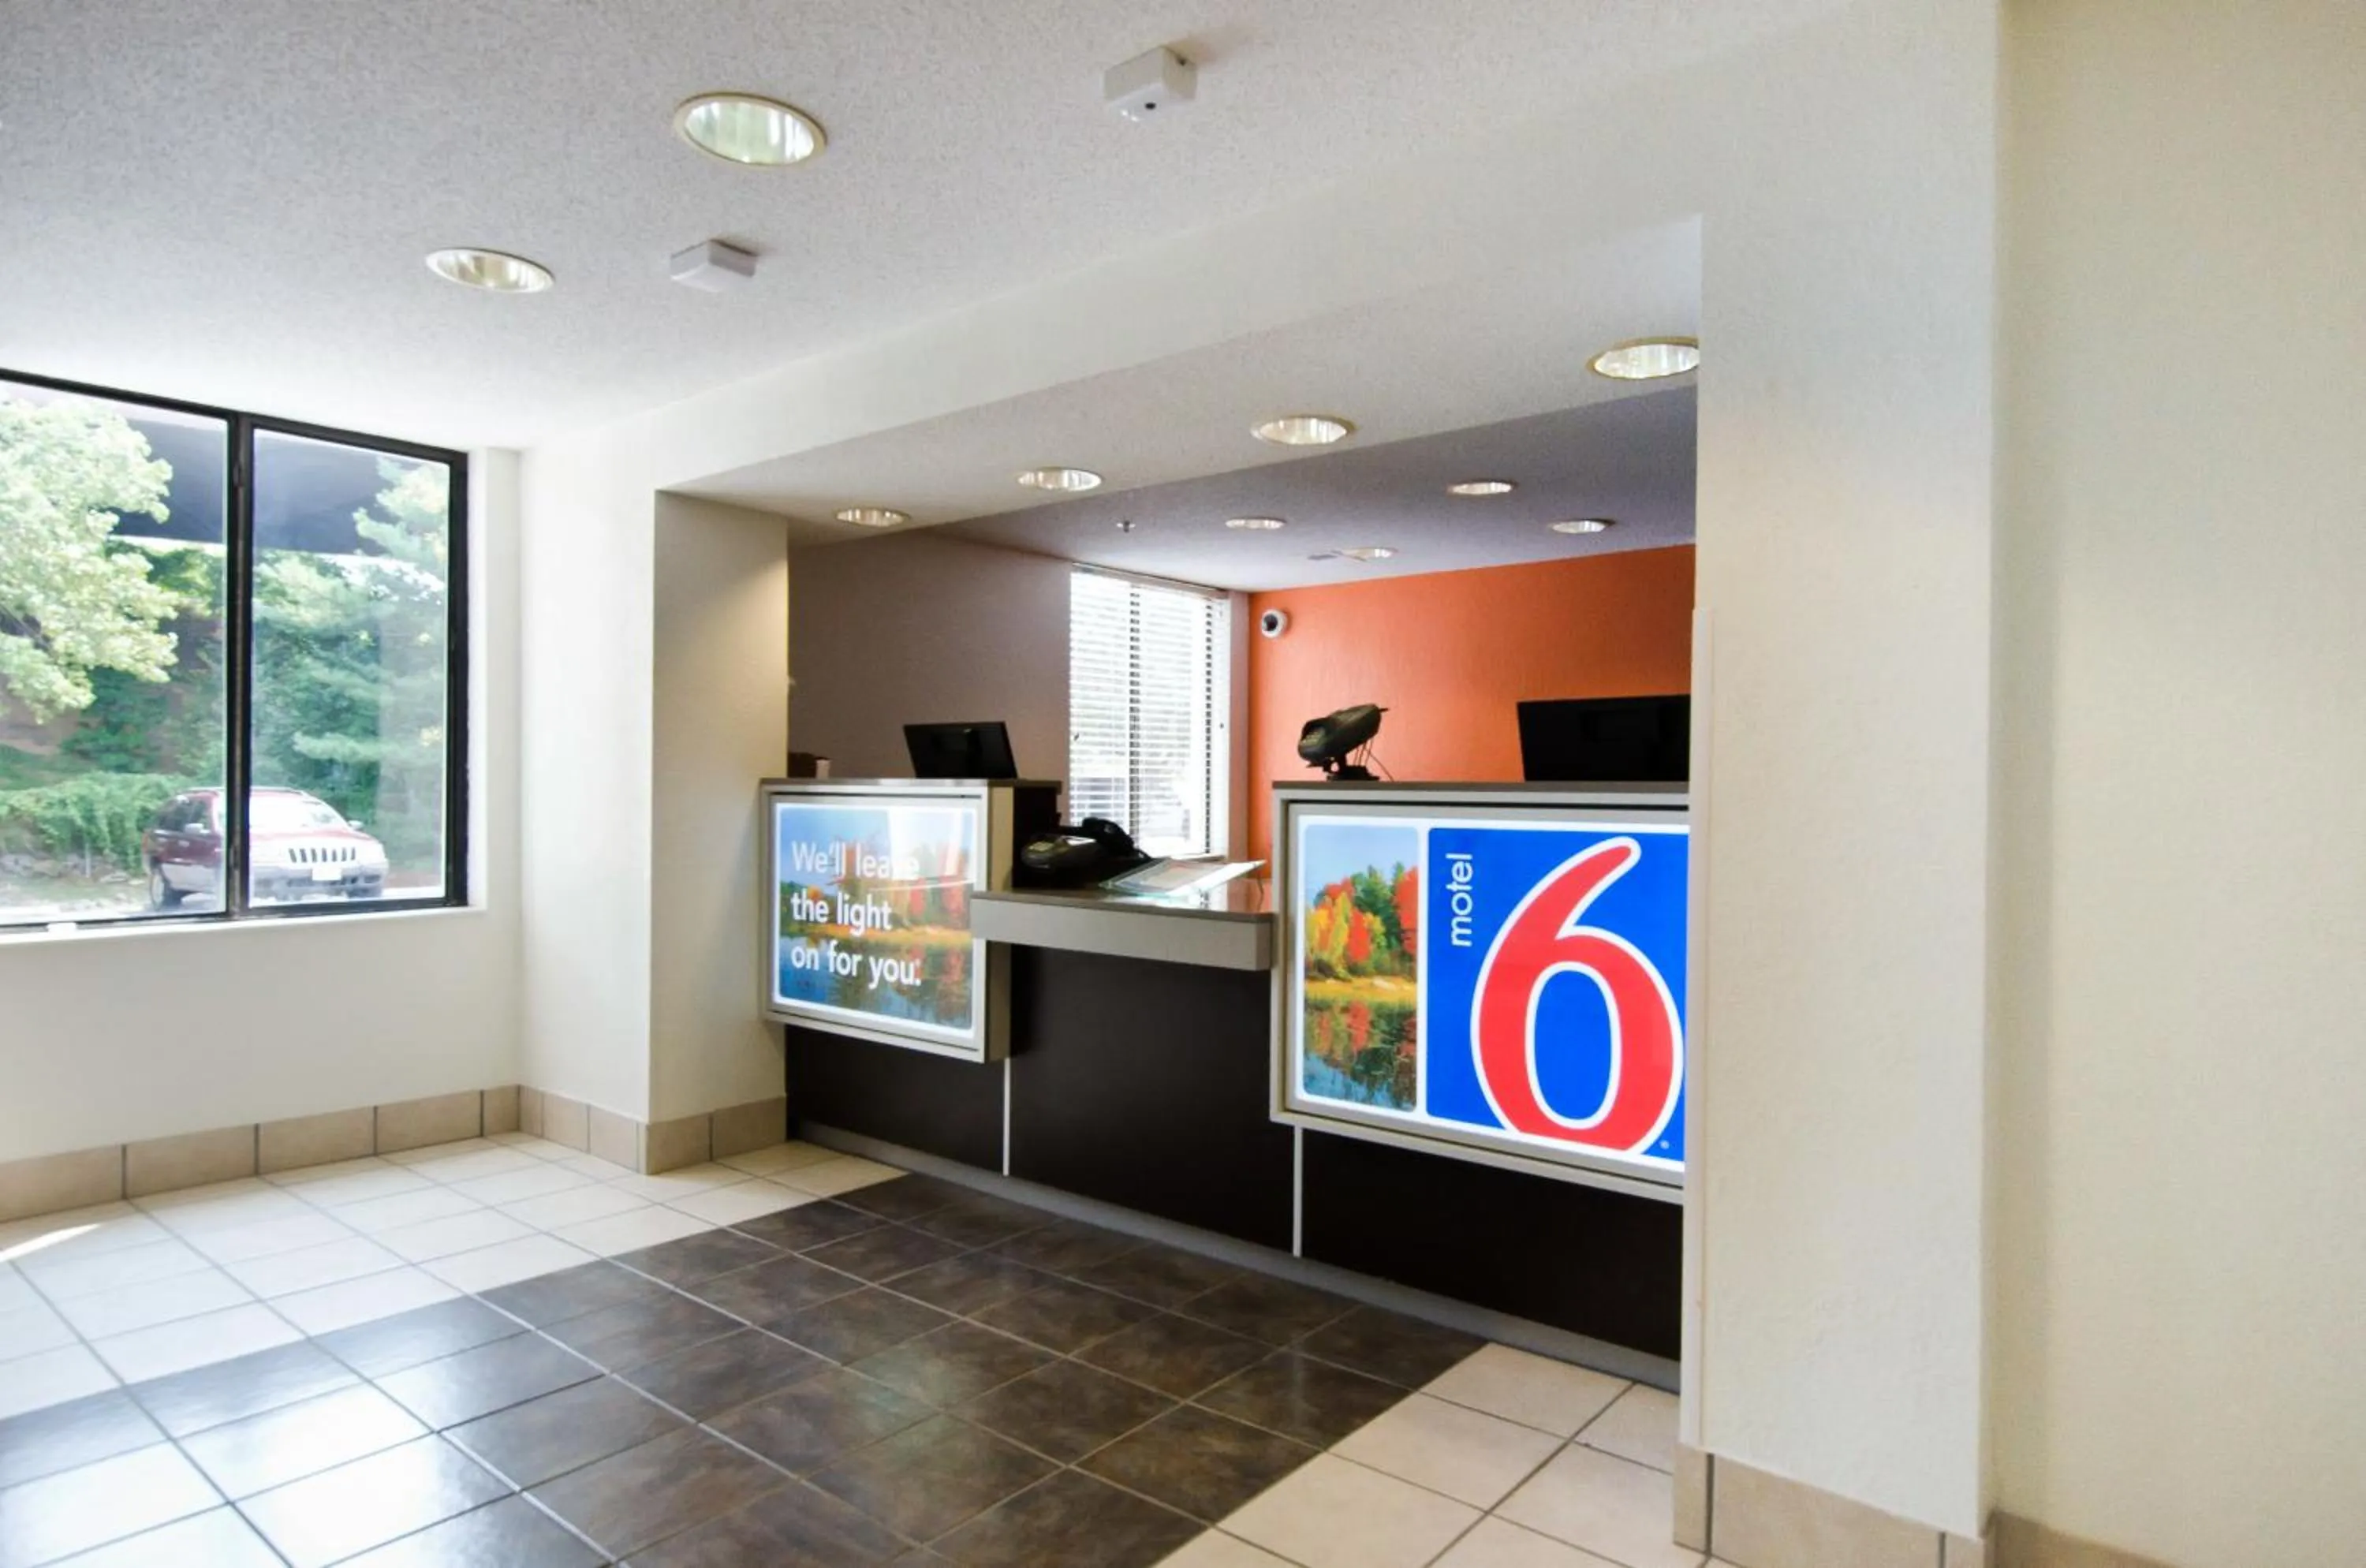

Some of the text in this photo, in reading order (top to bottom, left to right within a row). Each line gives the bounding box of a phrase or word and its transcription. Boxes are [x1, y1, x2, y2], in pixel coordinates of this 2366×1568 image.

[792, 841, 920, 880] We'll leae
[790, 889, 892, 936] the light
[1446, 853, 1472, 946] motel
[791, 945, 819, 970] on
[828, 940, 862, 976] for
[1470, 836, 1684, 1156] 6
